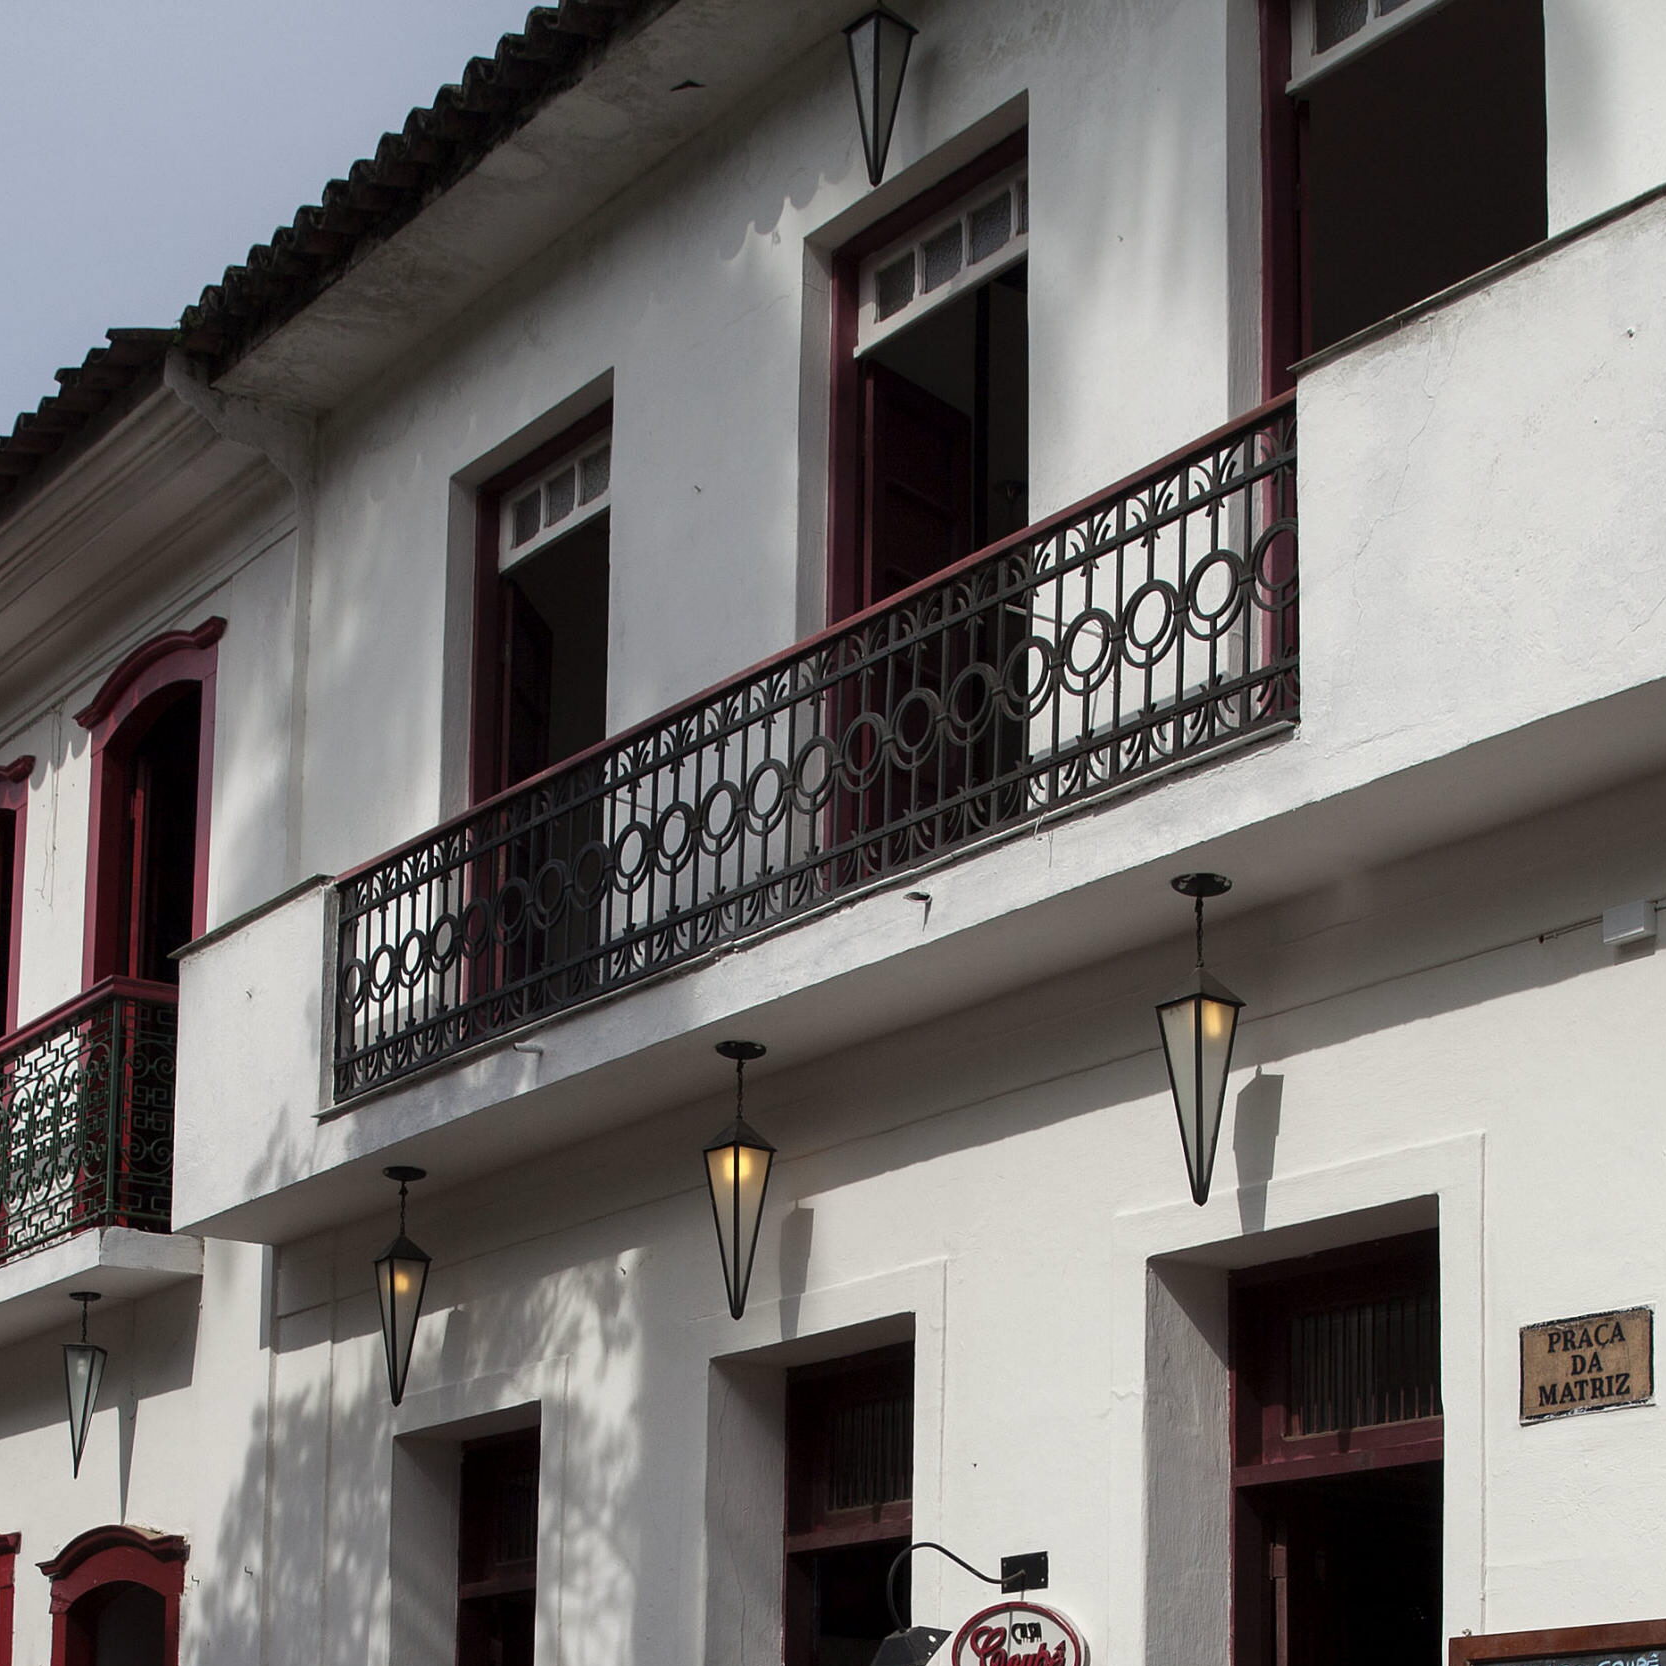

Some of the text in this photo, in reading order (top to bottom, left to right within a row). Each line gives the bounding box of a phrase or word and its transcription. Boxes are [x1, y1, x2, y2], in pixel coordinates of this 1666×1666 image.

[1548, 1321, 1626, 1354] PRAÇA
[1571, 1351, 1604, 1376] DA
[1538, 1372, 1631, 1407] MATRIZ
